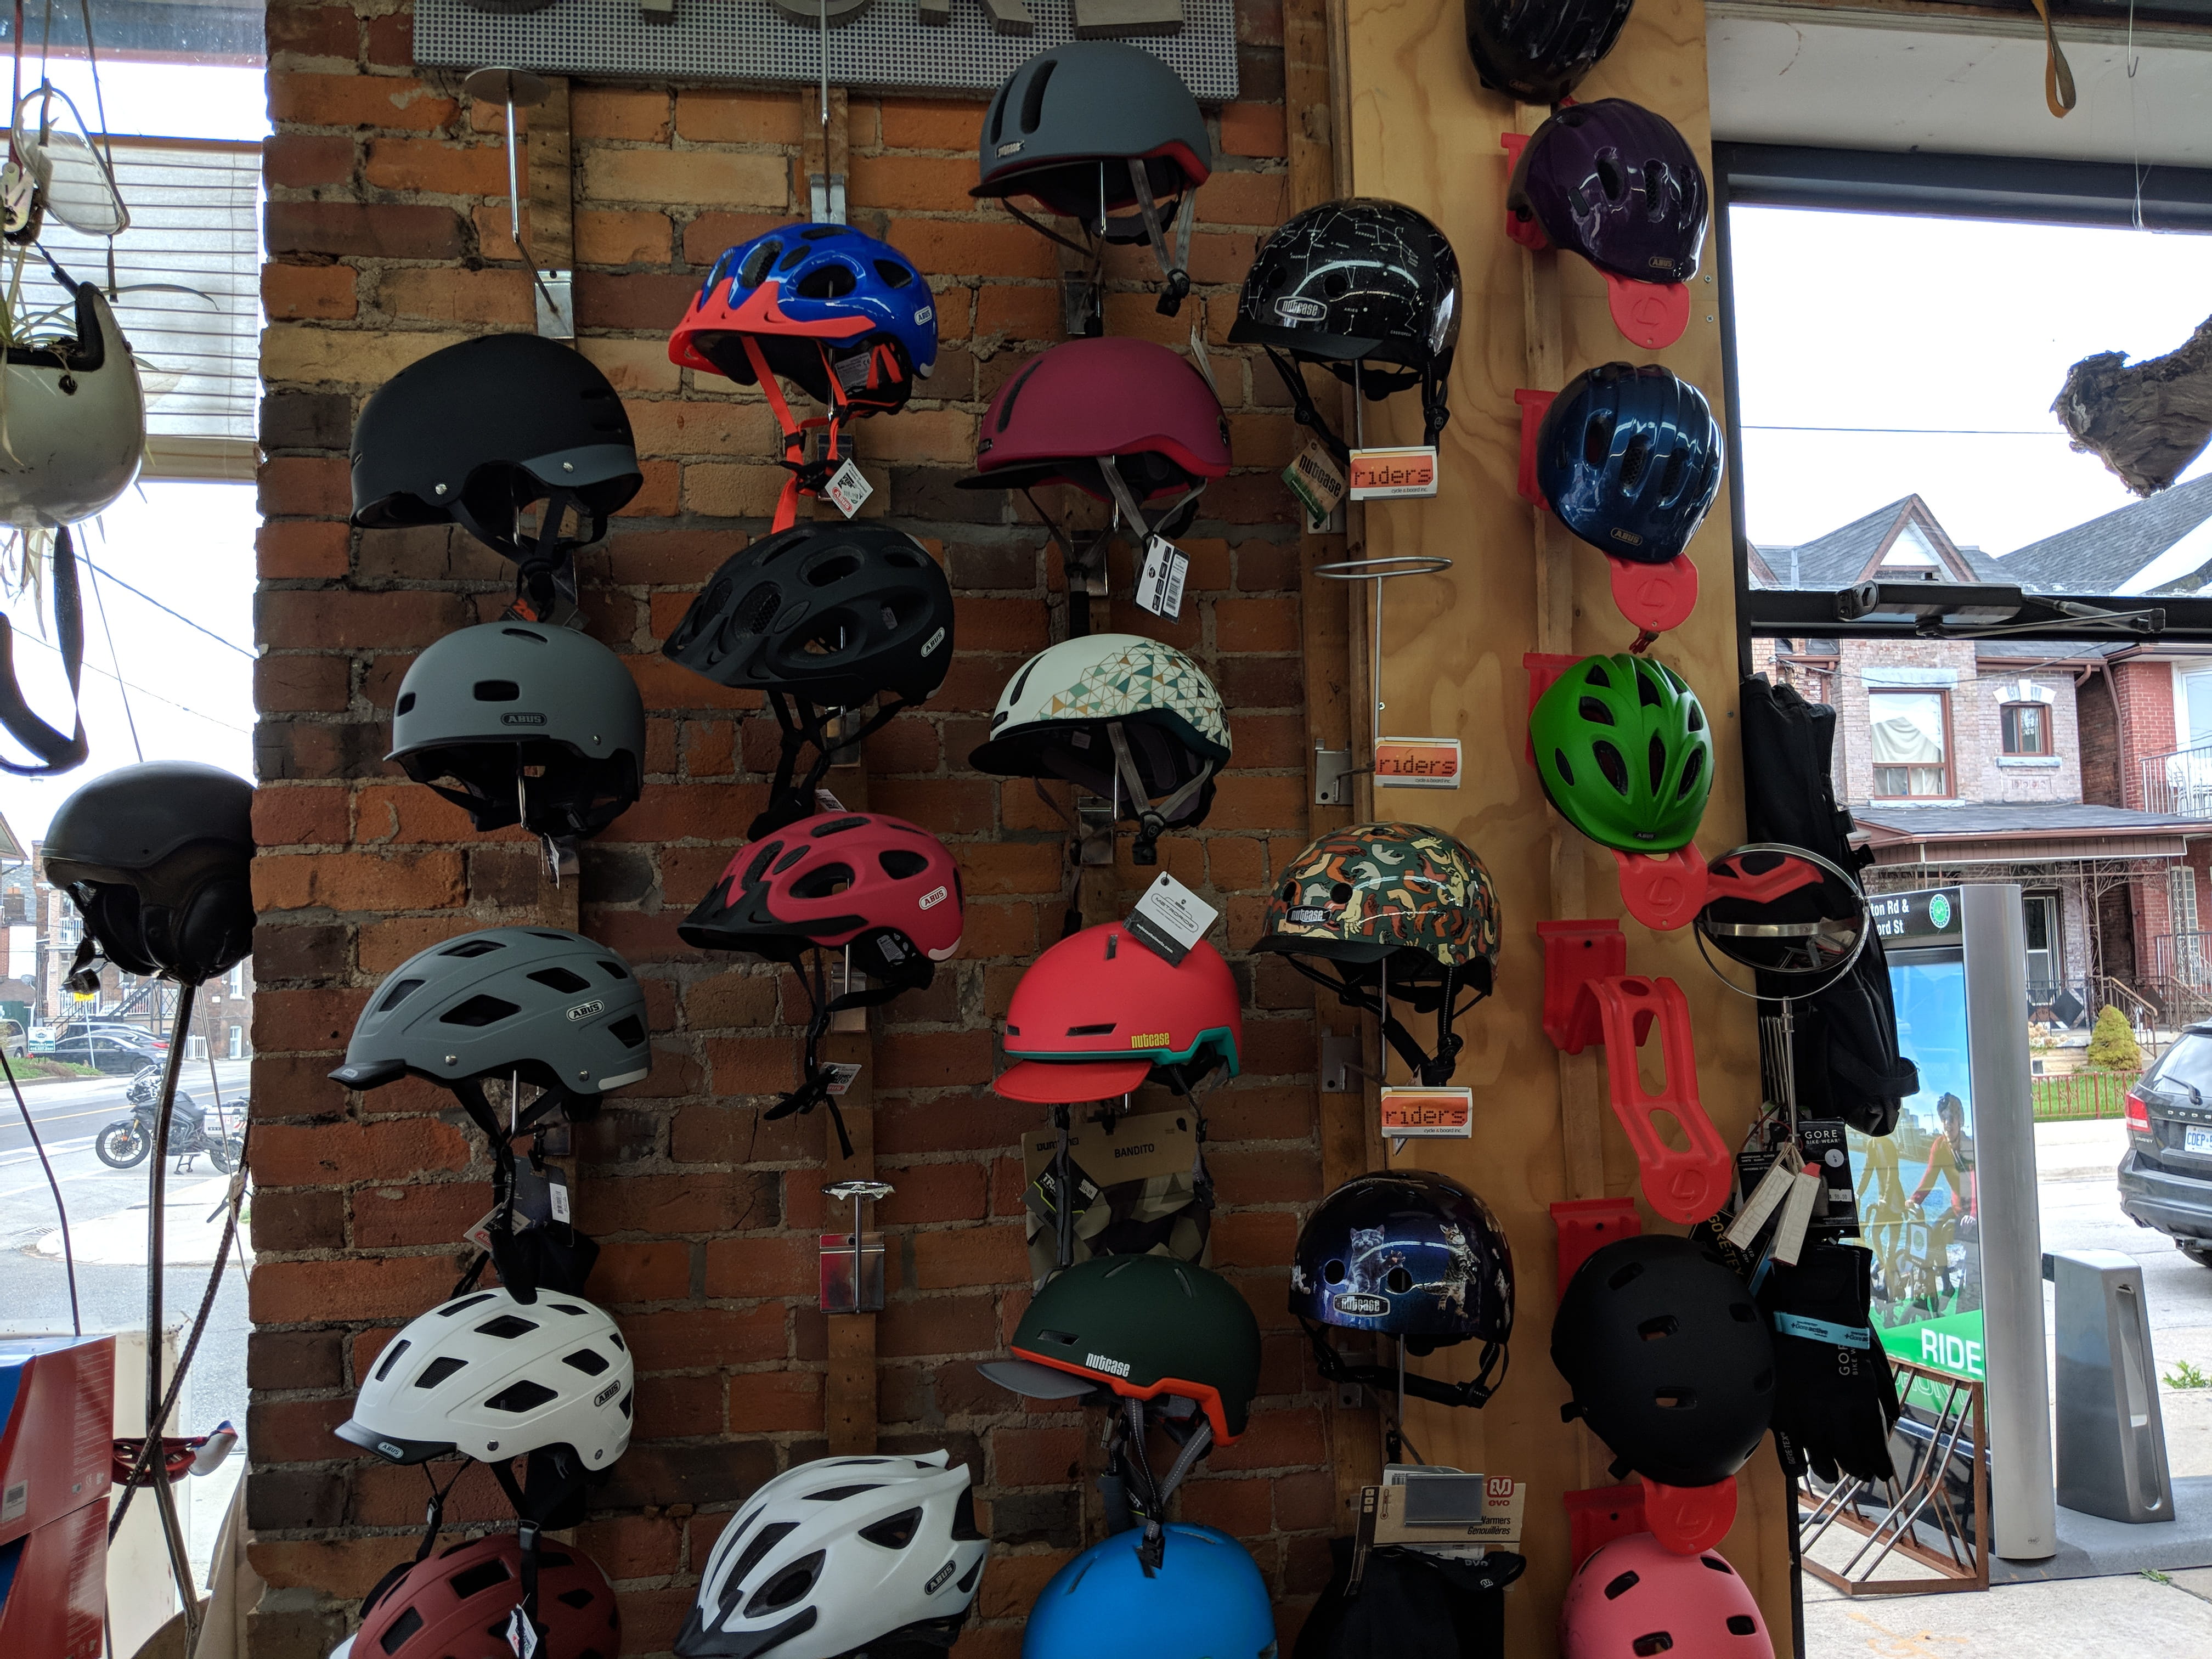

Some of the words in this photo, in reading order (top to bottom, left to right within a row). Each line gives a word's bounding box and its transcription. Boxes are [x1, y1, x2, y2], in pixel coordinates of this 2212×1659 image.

[1652, 258, 1673, 268] ABUS
[918, 309, 931, 322] ABUS
[1282, 300, 1318, 317] nutcase
[1299, 454, 1342, 498] nutcase
[1355, 466, 1431, 485] riders
[1615, 530, 1640, 544] ABUS
[926, 632, 943, 653] ABUS
[509, 715, 542, 724] ABUS
[1380, 755, 1455, 774] riders
[924, 889, 944, 906] ABUS
[1291, 909, 1323, 921] nutcase
[1871, 903, 1885, 917] ton
[1887, 900, 1899, 915] Rd
[1902, 899, 1909, 913] &
[1876, 921, 1892, 936] ord
[1893, 919, 1904, 934] St
[573, 1003, 600, 1018] ABUS
[1131, 1032, 1171, 1048] nutcase
[1386, 1106, 1465, 1124] riders
[2168, 1109, 2212, 1119] DODG
[1805, 1130, 1838, 1139] GORE
[2187, 1132, 2205, 1147] CDEP
[1037, 1138, 1074, 1152] BURTN
[1114, 1143, 1155, 1159] BANDITO
[1341, 1296, 1380, 1312] nutcase
[1921, 1327, 1983, 1375] RIDE
[1085, 1352, 1131, 1378] nutcase
[1850, 1358, 1859, 1376] BIKE
[599, 1383, 618, 1404] ABUS
[381, 1444, 399, 1455] ABUS
[1467, 1526, 1511, 1535] Genouillères
[929, 1563, 953, 1590] ABUS
